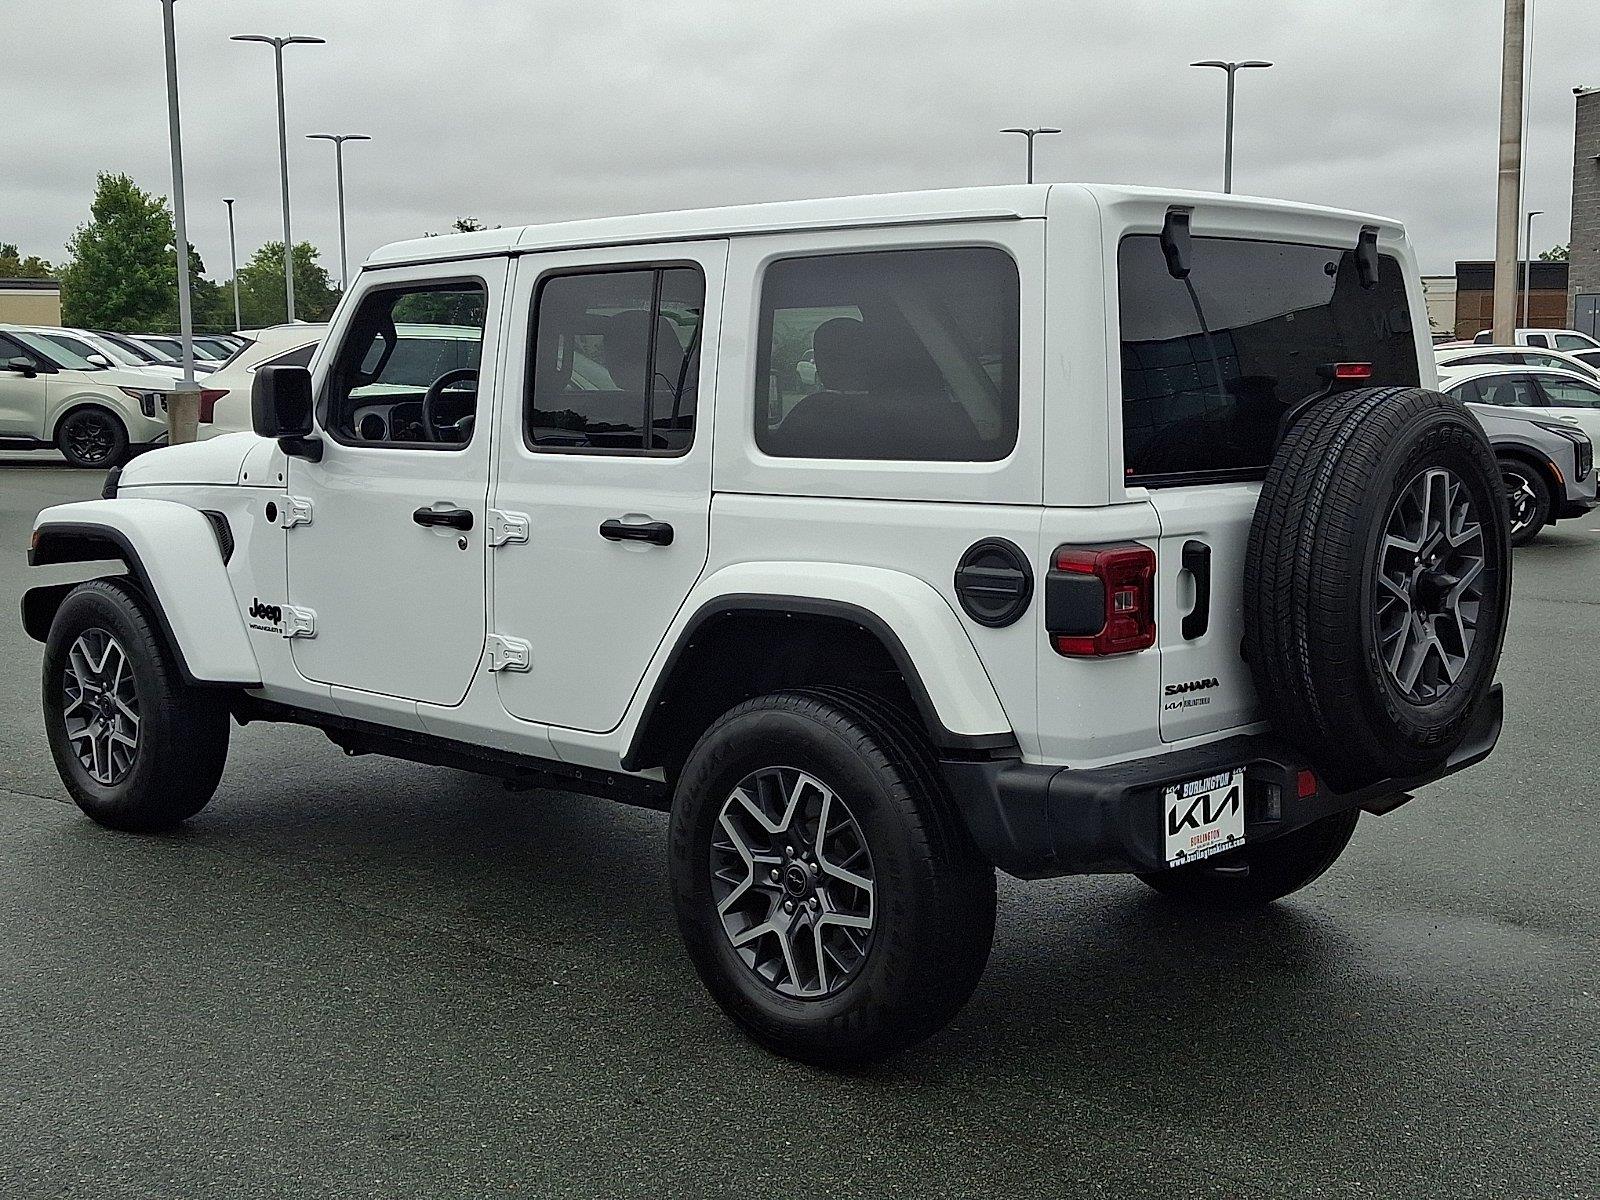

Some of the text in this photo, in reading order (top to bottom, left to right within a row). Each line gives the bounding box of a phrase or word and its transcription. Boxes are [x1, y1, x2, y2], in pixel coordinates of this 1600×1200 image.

[249, 597, 282, 626] Jeep
[1164, 677, 1220, 696] SAHARA
[1182, 772, 1231, 798] BURLINGTON
[1168, 785, 1240, 837] KIA
